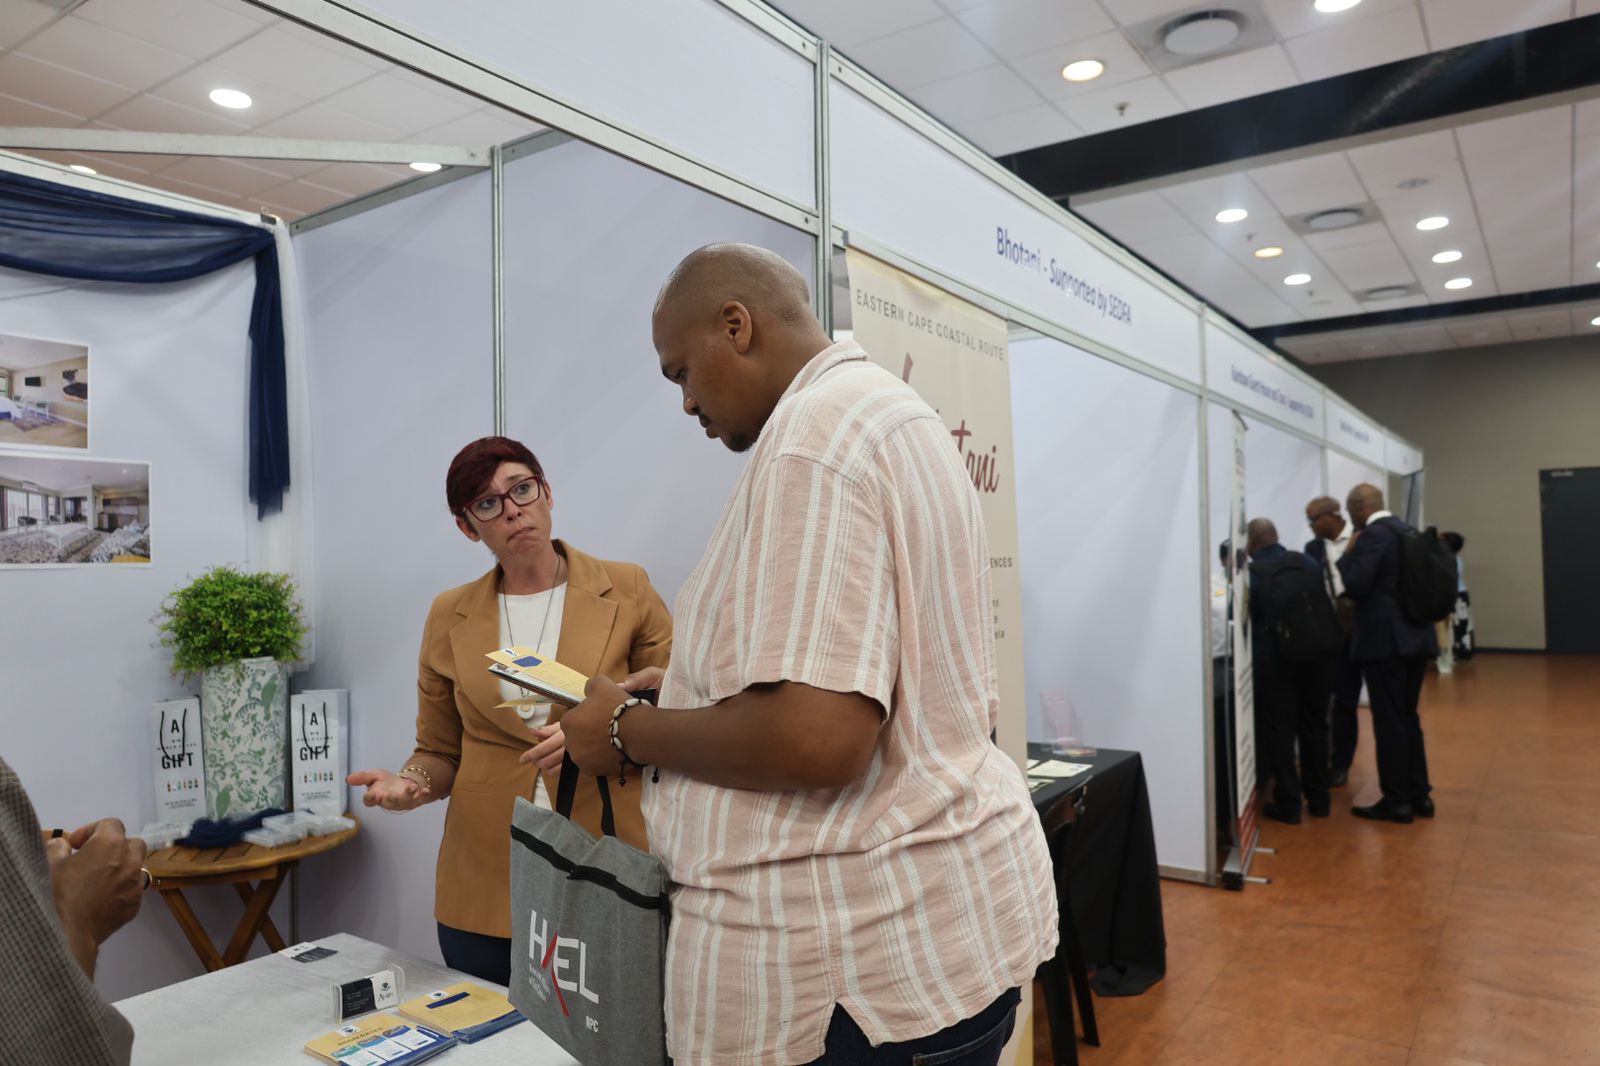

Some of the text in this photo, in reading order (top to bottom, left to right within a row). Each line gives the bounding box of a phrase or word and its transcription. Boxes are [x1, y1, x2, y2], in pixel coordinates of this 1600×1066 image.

[996, 227, 1040, 272] Bhotani
[1050, 258, 1096, 306] Supported
[1097, 288, 1108, 318] by
[856, 289, 1004, 361] EASTERN CAPE COASTAL ROUTE
[171, 719, 180, 733] A
[310, 712, 319, 726] A
[162, 752, 194, 769] GIFT
[300, 745, 331, 761] GIFT
